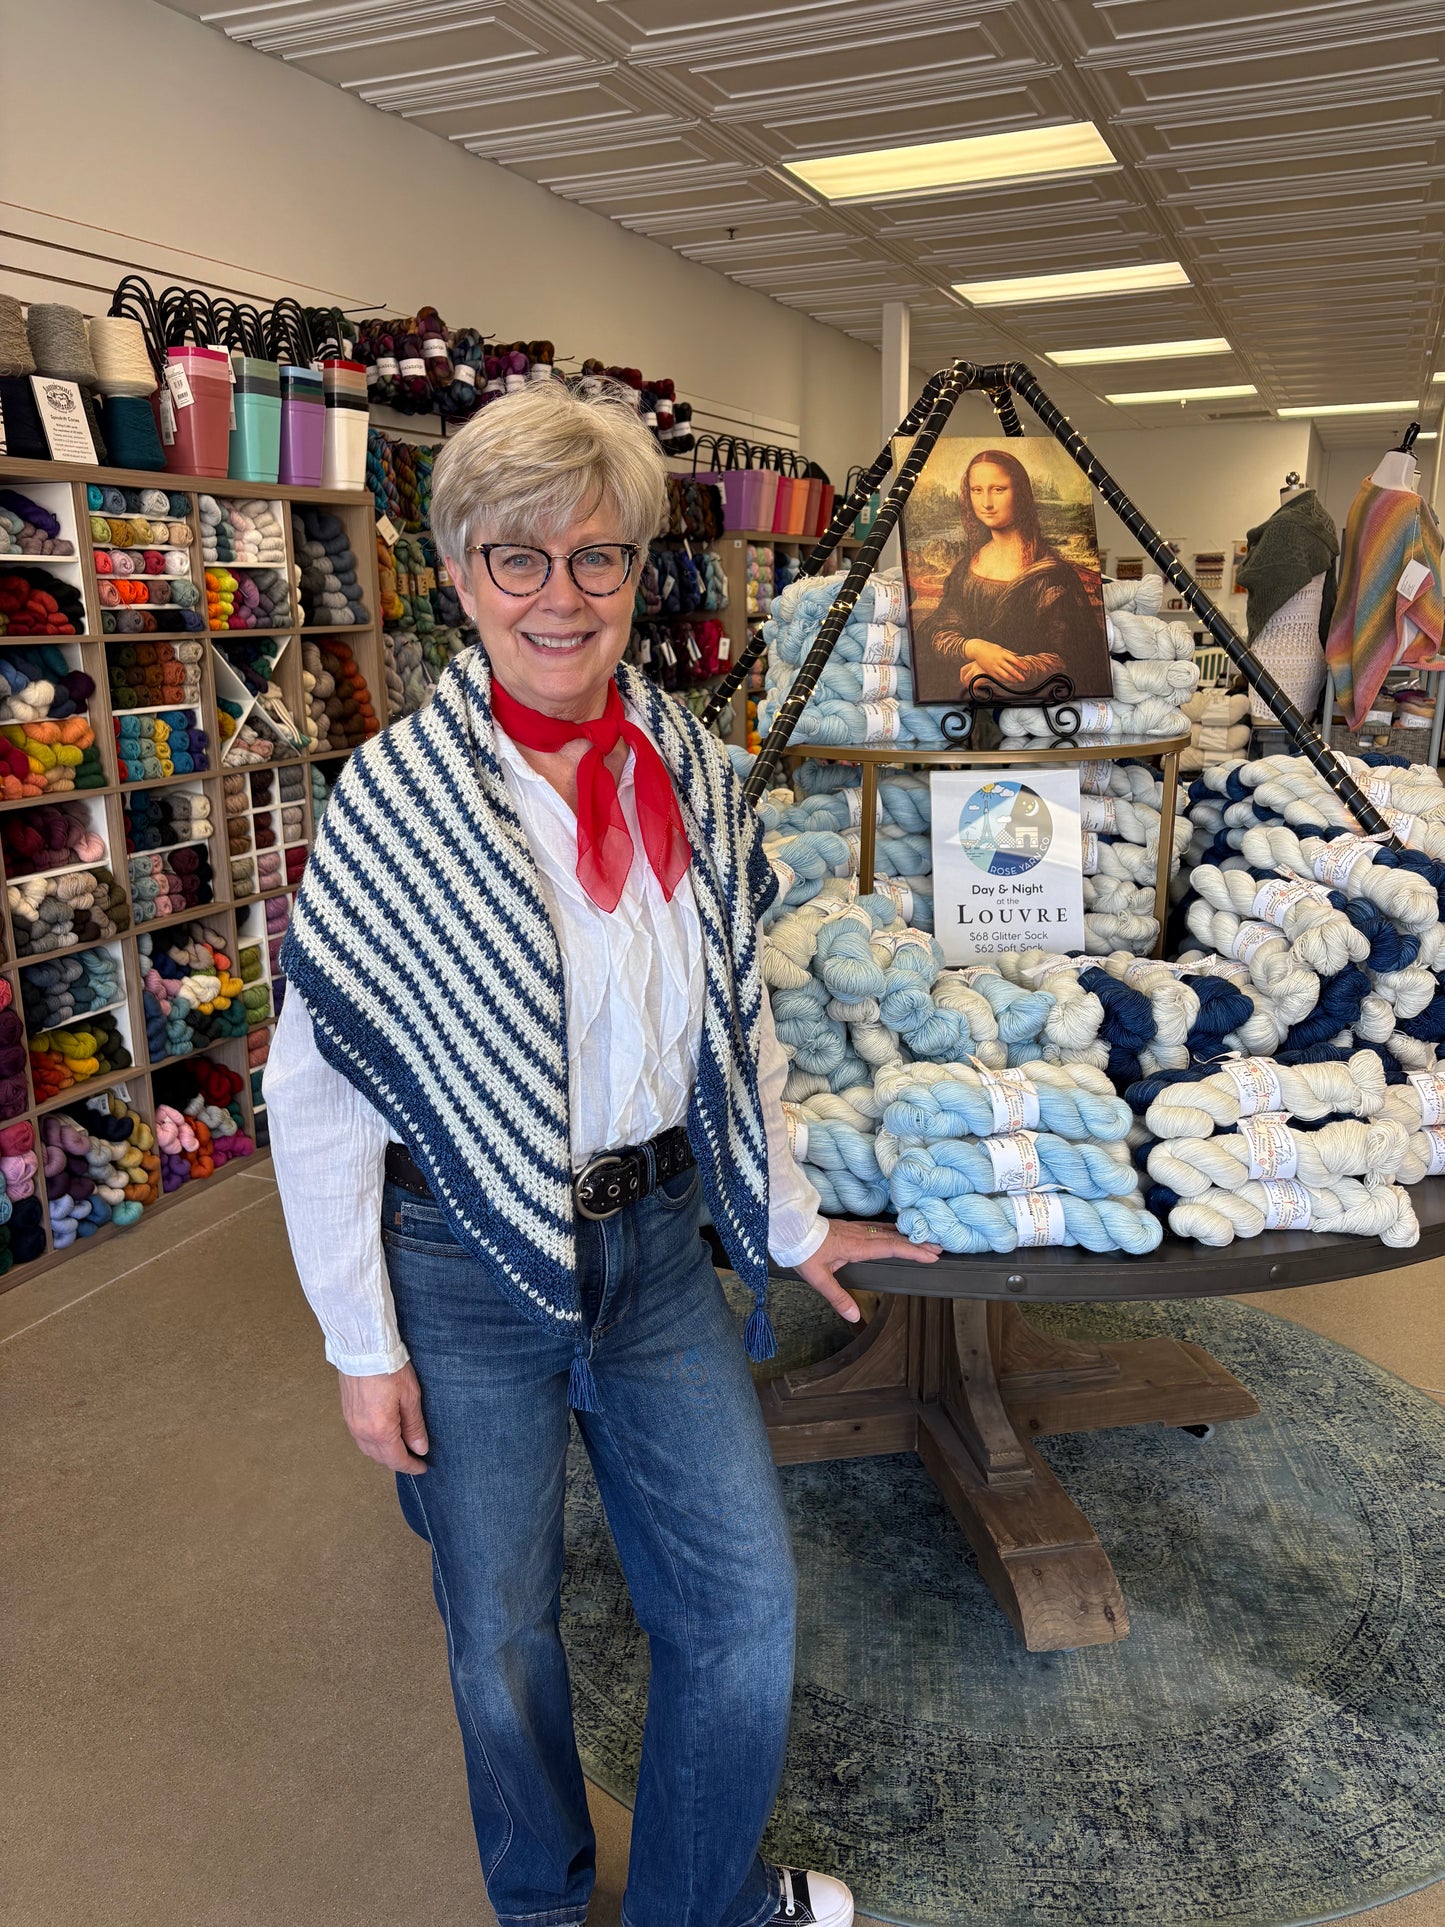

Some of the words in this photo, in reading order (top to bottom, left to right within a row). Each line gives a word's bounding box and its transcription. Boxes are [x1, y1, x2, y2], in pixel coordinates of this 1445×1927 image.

[990, 865, 1018, 876] ROSE
[1018, 851, 1042, 872] YARN
[972, 884, 995, 896] Day
[998, 884, 1008, 894] &
[1012, 883, 1044, 896] Night
[1006, 897, 1020, 905] the
[969, 931, 989, 941] $68
[991, 931, 1022, 941] Glitter
[1024, 930, 1049, 940] Sock
[974, 943, 994, 953] $62
[997, 943, 1017, 953] Soft
